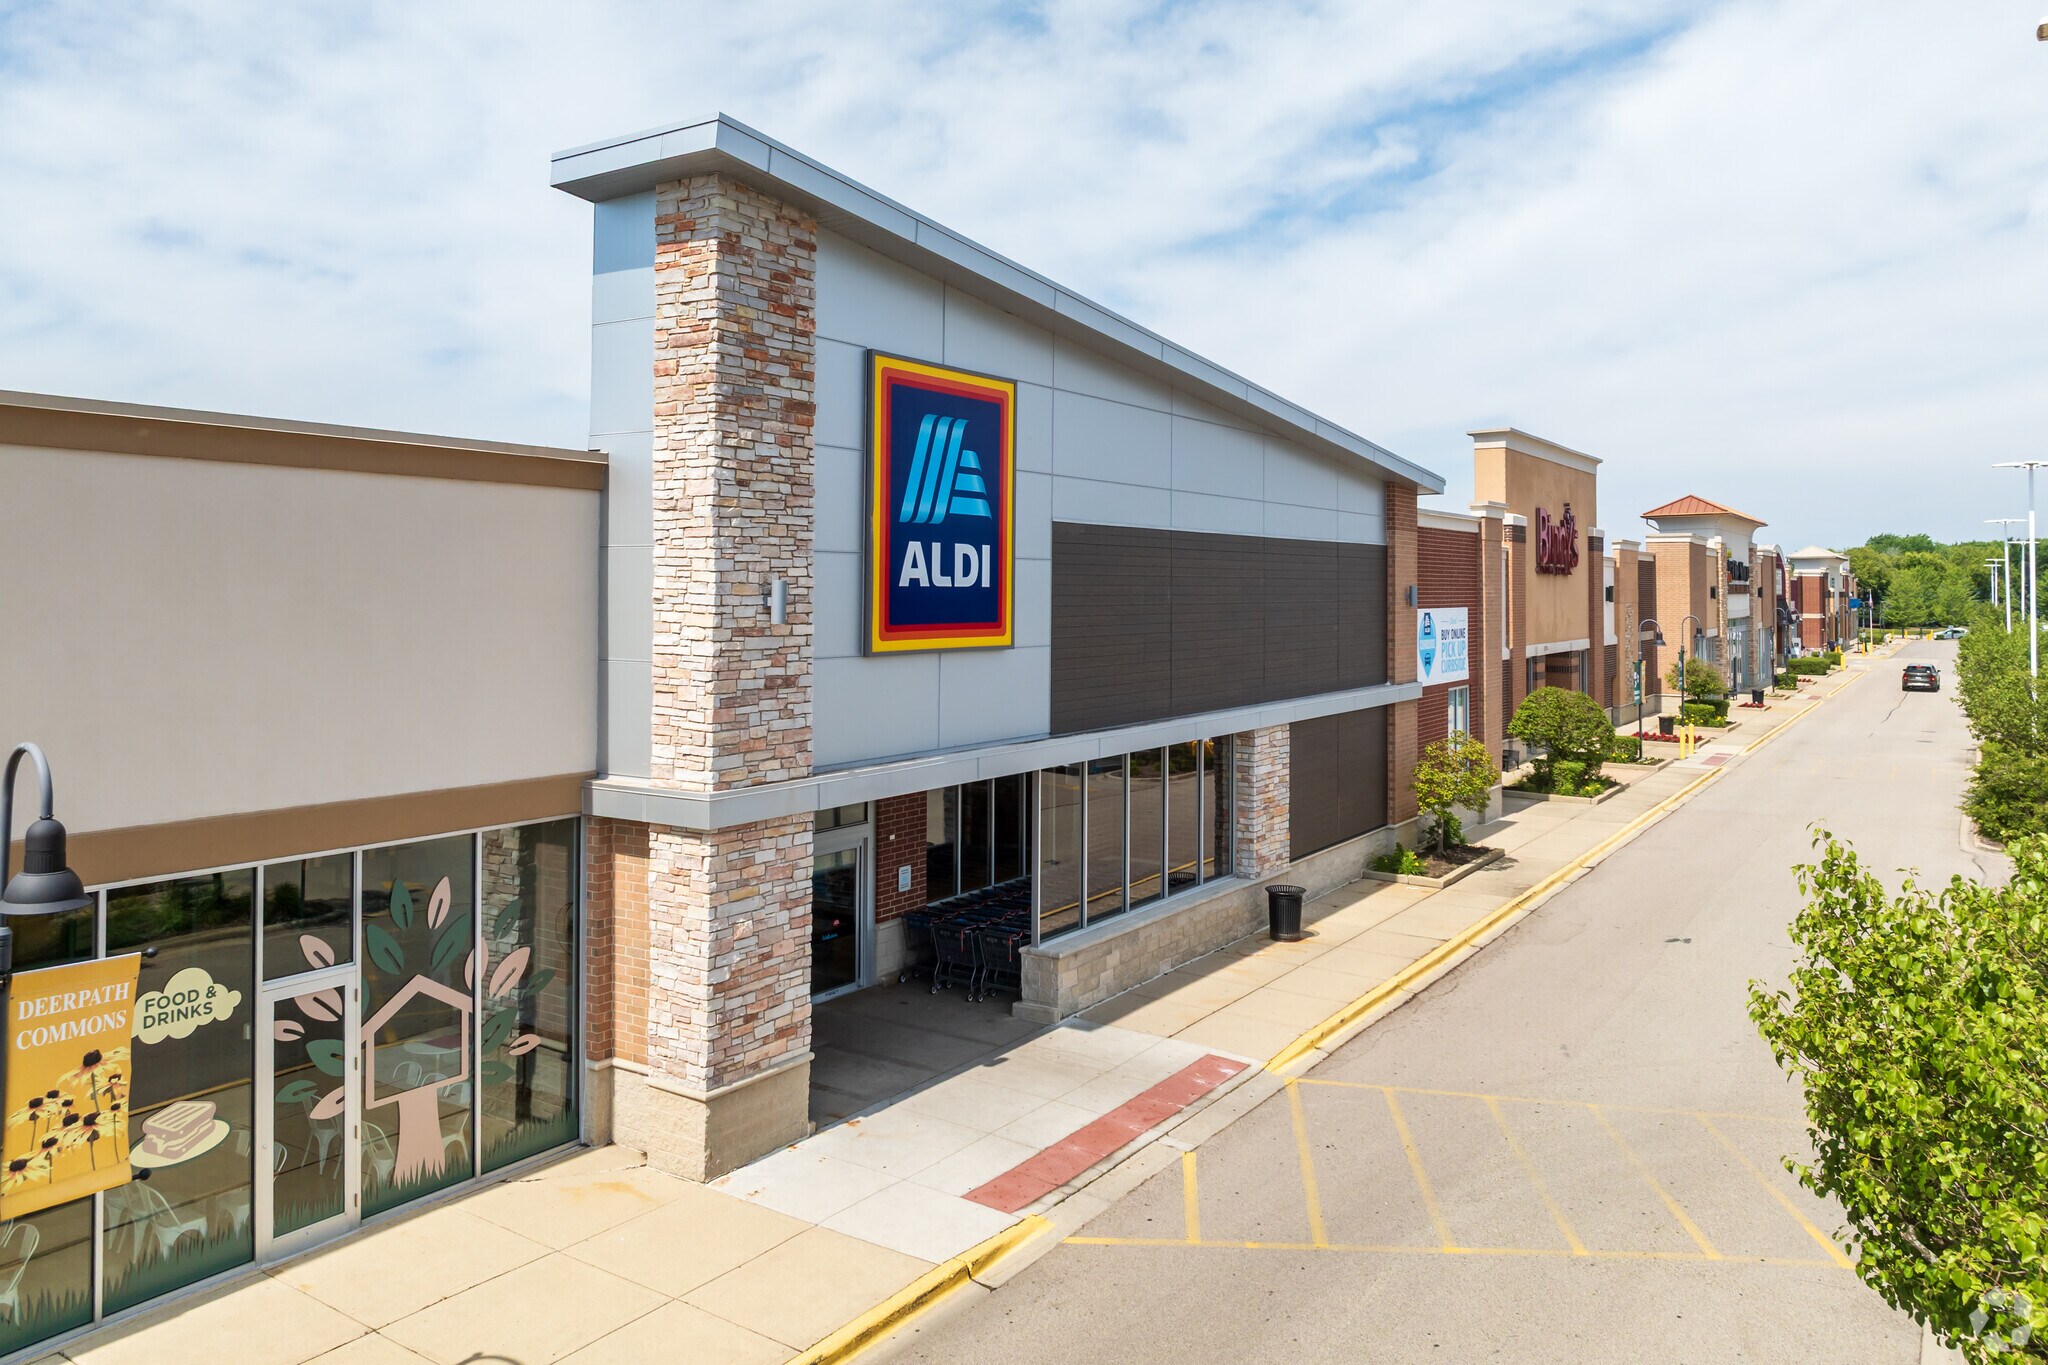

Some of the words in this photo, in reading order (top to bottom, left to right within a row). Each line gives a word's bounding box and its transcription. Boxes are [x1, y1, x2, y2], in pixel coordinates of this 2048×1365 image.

[898, 540, 992, 588] ALDI
[1441, 629, 1451, 641] BUY
[1451, 628, 1466, 640] ONLINE
[1441, 641, 1456, 658] PICK
[1457, 640, 1466, 657] UP
[1441, 657, 1466, 673] CURBSIDE
[18, 982, 130, 1020] DEERPATH
[145, 989, 200, 1013] FOOD
[205, 985, 217, 999] &
[143, 1001, 213, 1029] DRINKS
[16, 1009, 127, 1050] COMMONS
